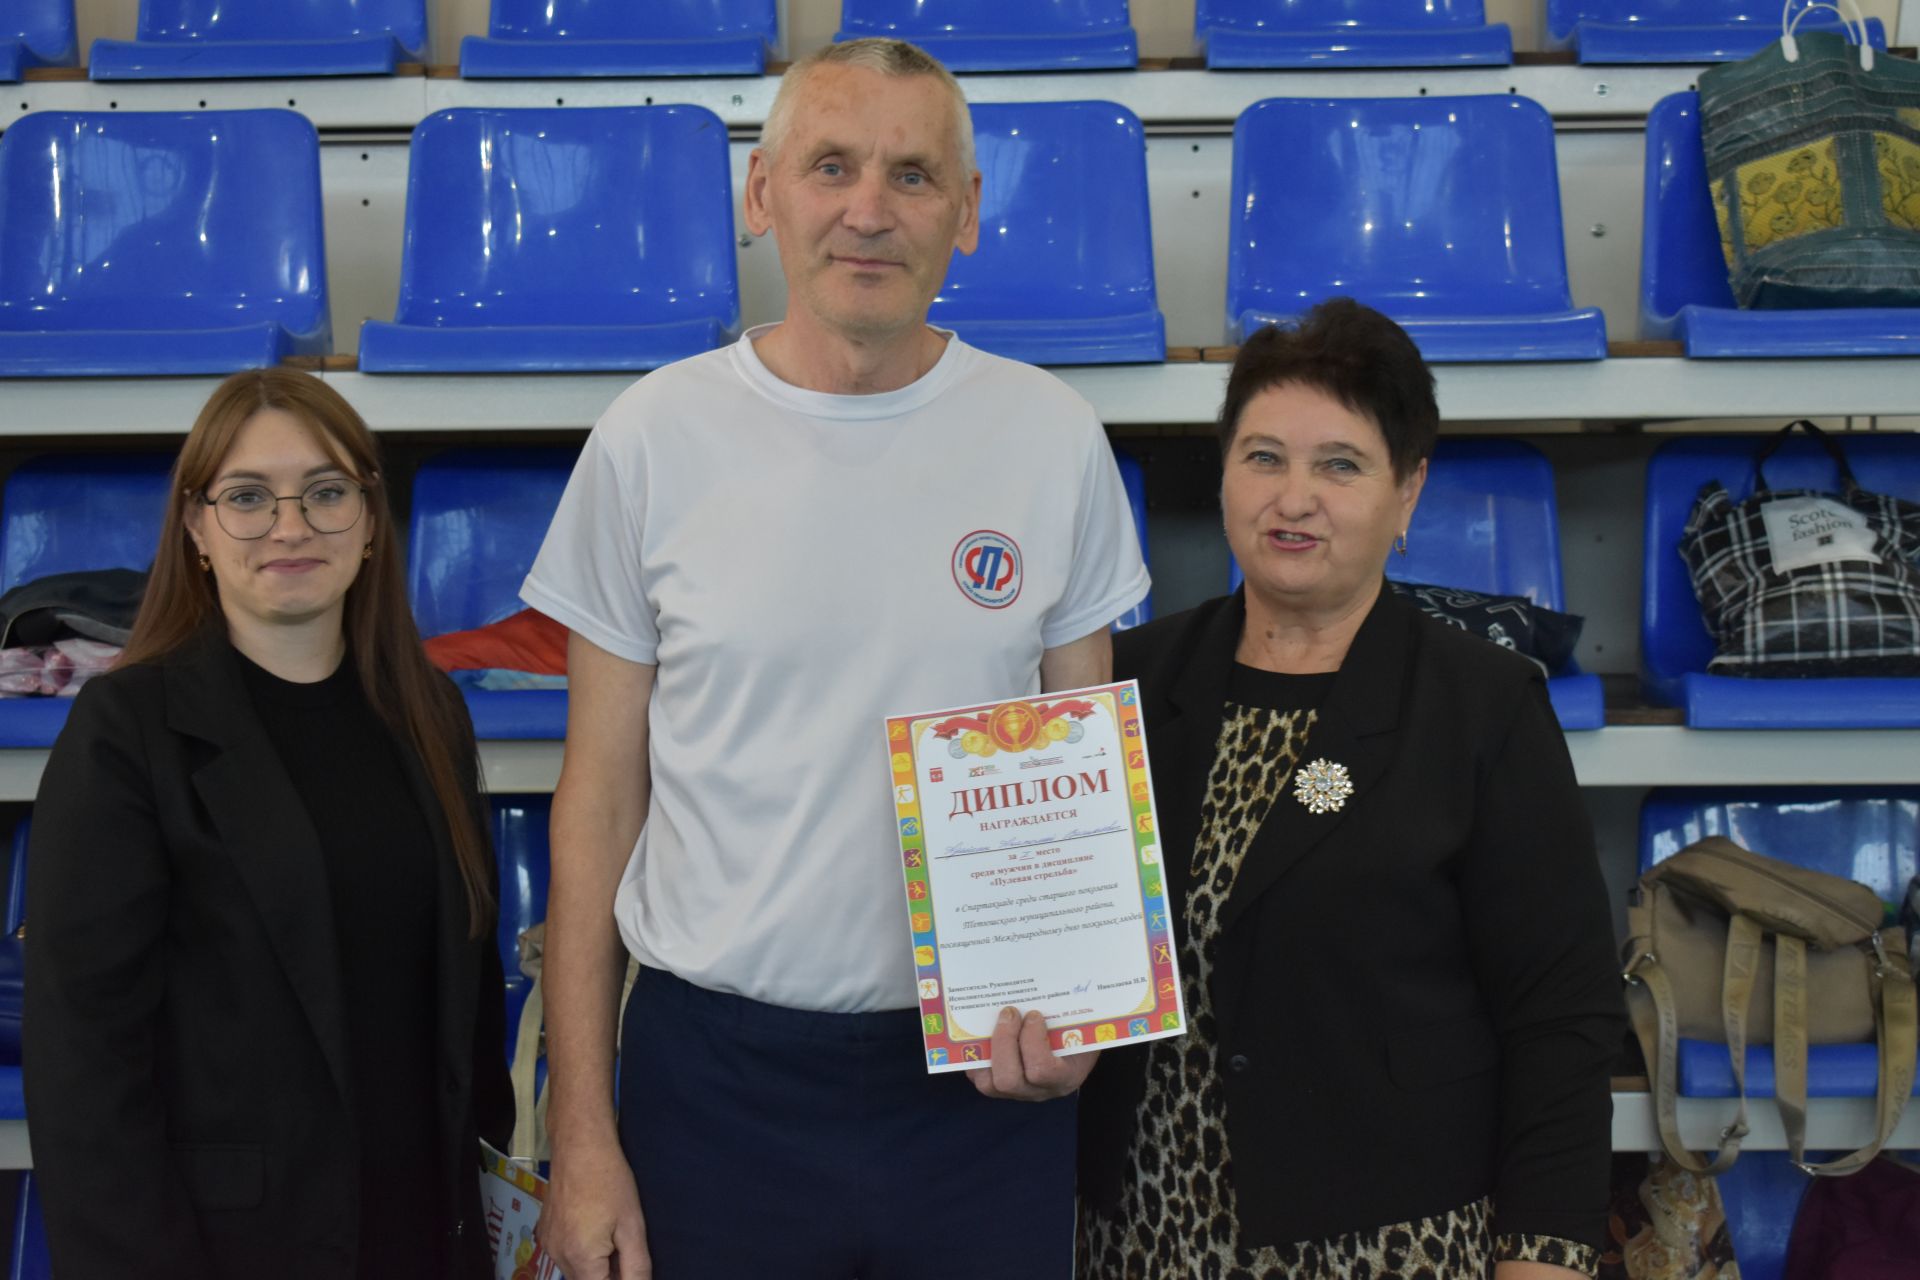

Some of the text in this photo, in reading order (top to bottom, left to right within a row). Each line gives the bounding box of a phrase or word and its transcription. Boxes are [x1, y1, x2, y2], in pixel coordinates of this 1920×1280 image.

[1792, 519, 1853, 541] fashion
[949, 768, 1111, 821] ДИПЛОМ
[979, 808, 1078, 832] НАГРАЖДАЕТСЯ
[1008, 852, 1017, 861] за
[1036, 846, 1061, 857] место
[970, 868, 996, 880] среди
[998, 863, 1032, 876] мужчин
[1042, 854, 1095, 869] дисциплине
[990, 868, 1078, 887] «Пулевая стрельба»
[961, 898, 1014, 913] Спартакиаде
[1016, 893, 1038, 907] среди
[1039, 890, 1076, 904] старшего
[1078, 882, 1119, 897] поколения
[962, 914, 1017, 930] Тетюшского
[1018, 906, 1084, 924] муниципального
[992, 927, 1063, 944] Международному
[1064, 923, 1080, 933] дню
[1081, 917, 1118, 931] пожилых
[1118, 912, 1144, 925] людей
